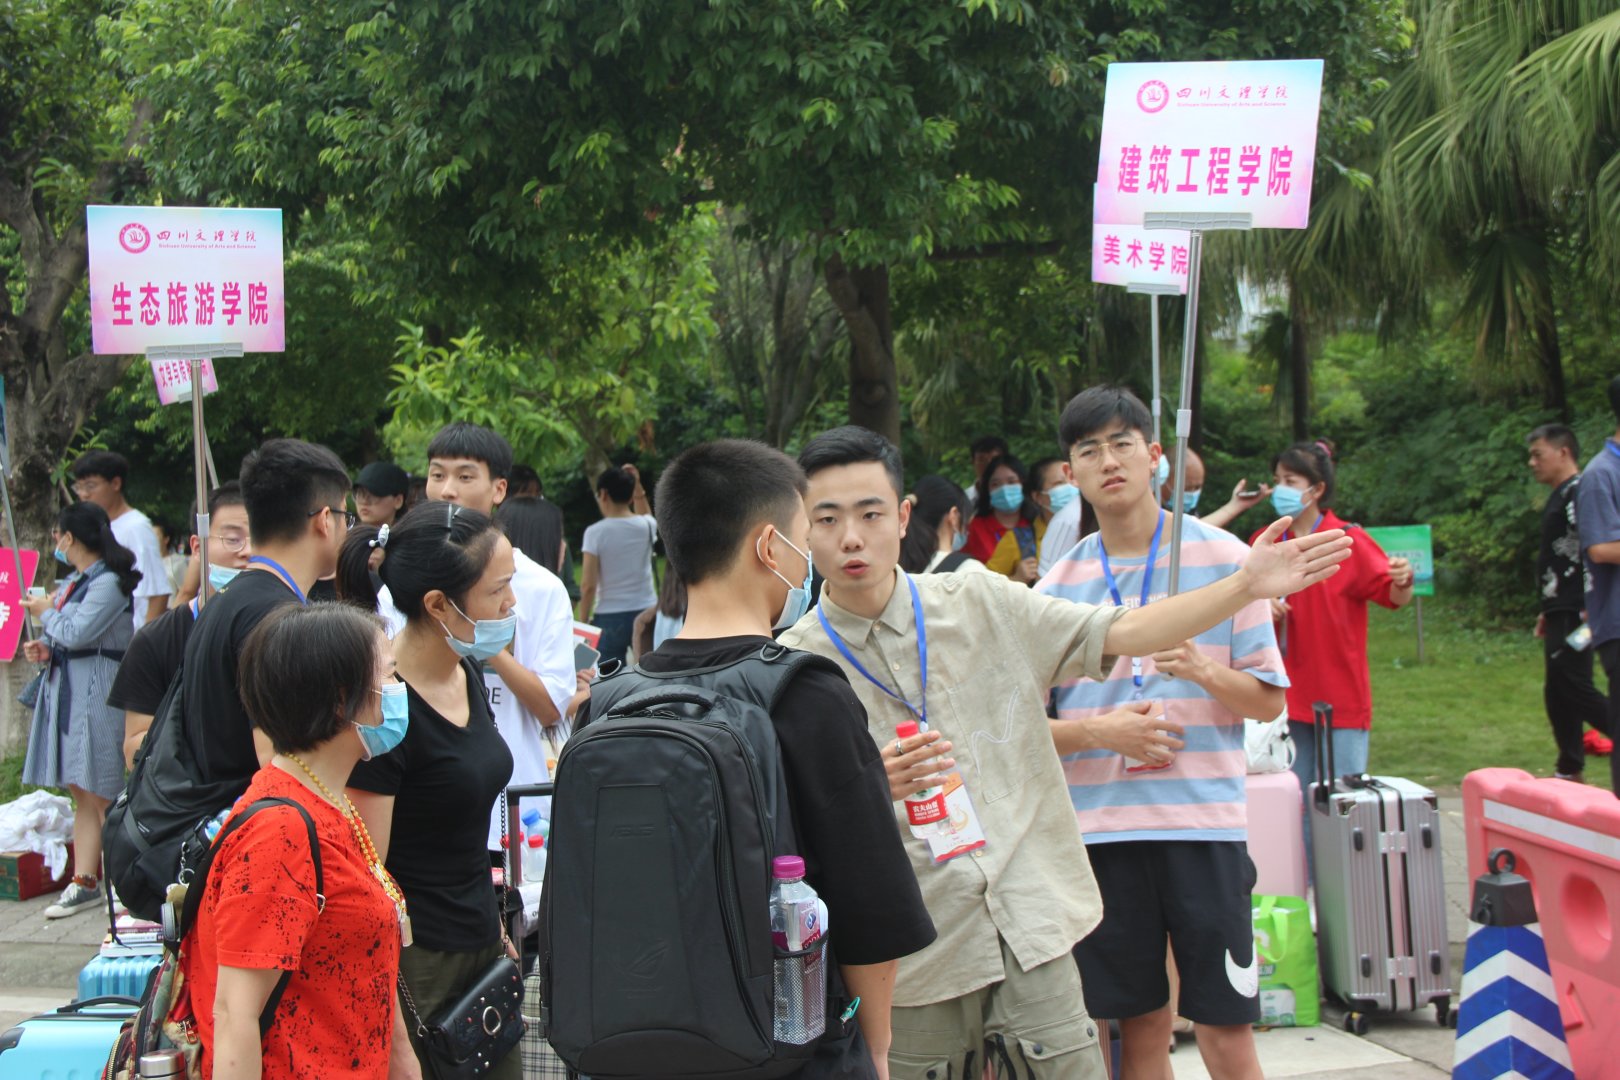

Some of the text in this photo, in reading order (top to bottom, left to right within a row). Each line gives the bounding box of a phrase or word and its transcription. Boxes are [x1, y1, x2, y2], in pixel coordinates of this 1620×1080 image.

[1176, 84, 1288, 99] 四川文理学院
[1118, 144, 1293, 196] 建筑工程学院
[156, 228, 256, 242] 四川文理学院
[1103, 235, 1188, 275] 美术学院
[111, 281, 269, 326] 生态旅游学院
